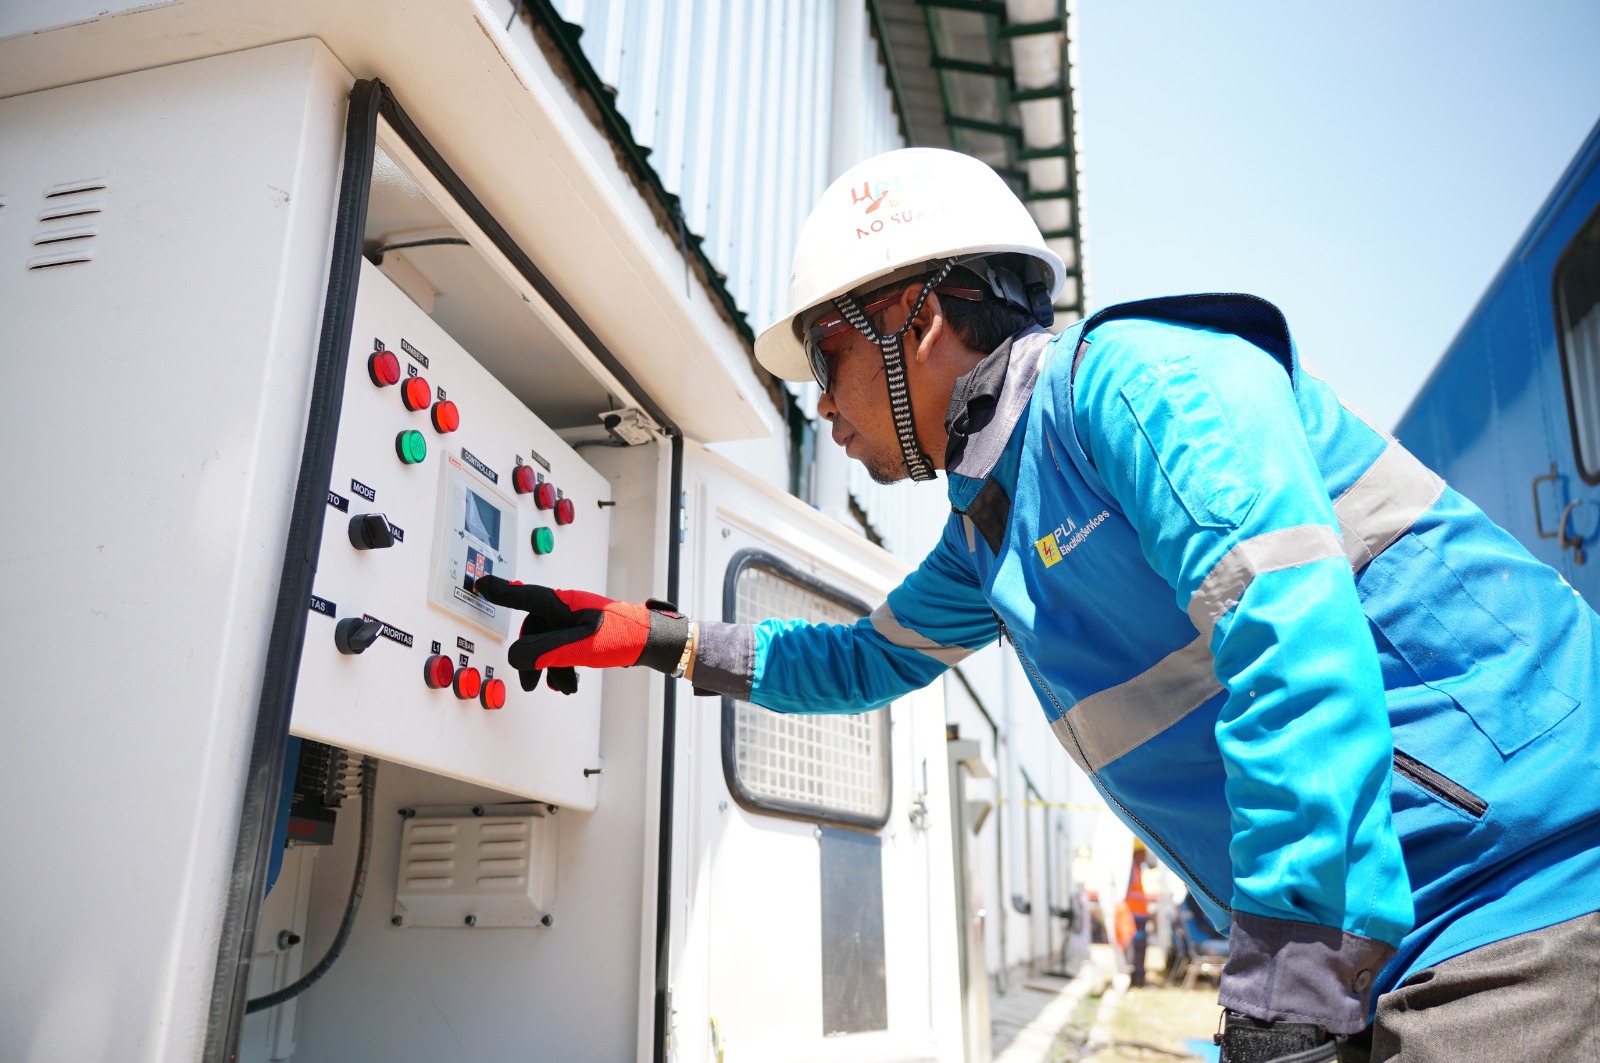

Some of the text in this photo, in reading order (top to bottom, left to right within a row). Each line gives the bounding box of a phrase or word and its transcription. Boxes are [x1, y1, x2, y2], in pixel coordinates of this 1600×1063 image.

[377, 341, 383, 351] L1
[402, 341, 424, 364] SUMBER
[409, 366, 416, 377] L2
[464, 451, 495, 481] CONTROLLER
[353, 481, 374, 499] MODE
[311, 598, 325, 611] TAS
[383, 626, 412, 645] RIORITAS
[433, 642, 440, 652] L1
[458, 639, 474, 652] BEBAN
[461, 656, 467, 665] L2
